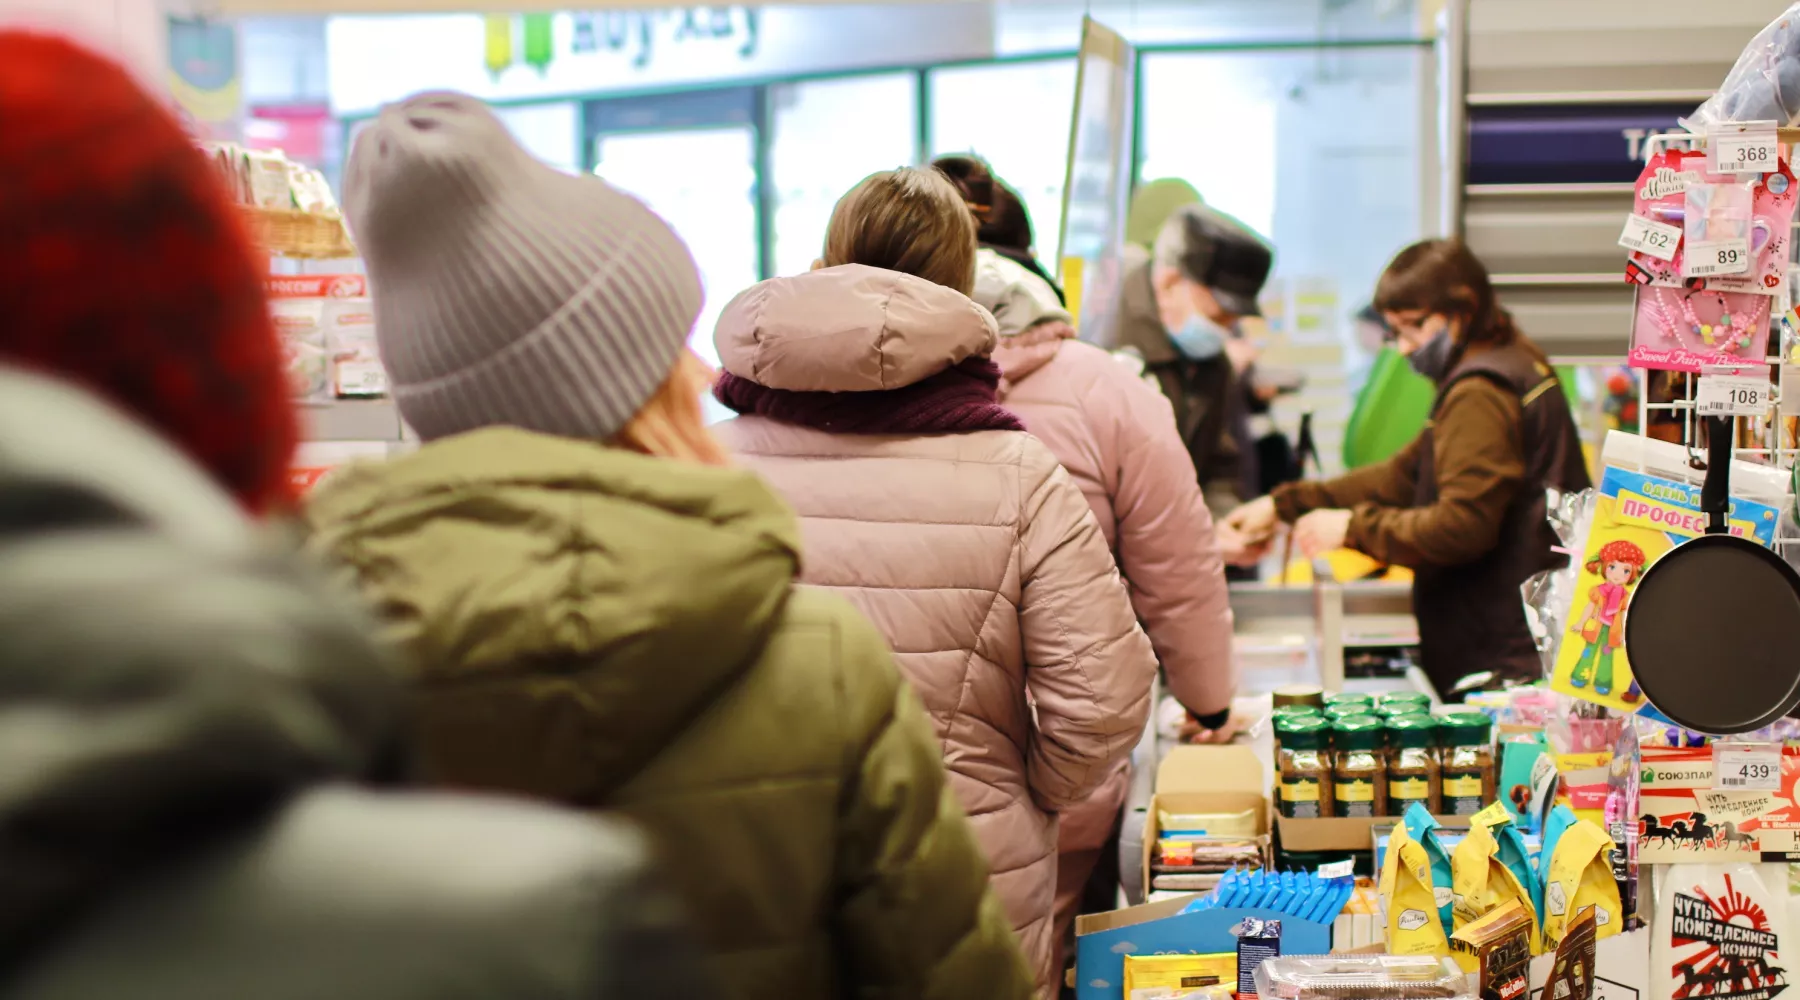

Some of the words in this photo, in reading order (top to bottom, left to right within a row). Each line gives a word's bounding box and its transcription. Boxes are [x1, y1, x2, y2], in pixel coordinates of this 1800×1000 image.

[1737, 147, 1767, 161] 368
[1642, 229, 1668, 248] 162
[1718, 249, 1737, 264] 89
[1634, 346, 1671, 363] Sweet
[1671, 350, 1706, 370] Fairy
[1728, 389, 1758, 404] 108
[1642, 481, 1688, 503] ОДЕНЬ
[1623, 499, 1744, 537] ПРОФЕСИ
[1657, 771, 1713, 781] СОЮЗПАР
[1739, 764, 1769, 778] 439
[1705, 793, 1728, 804] ЧУТЬ
[1710, 797, 1769, 815] ПОМЕДЛЕННЕЕ
[1674, 896, 1713, 921] ЧУТЬ
[1674, 915, 1775, 946] ПОМЕДЛЕННЕЕ
[1720, 942, 1763, 958] КОНИ!
